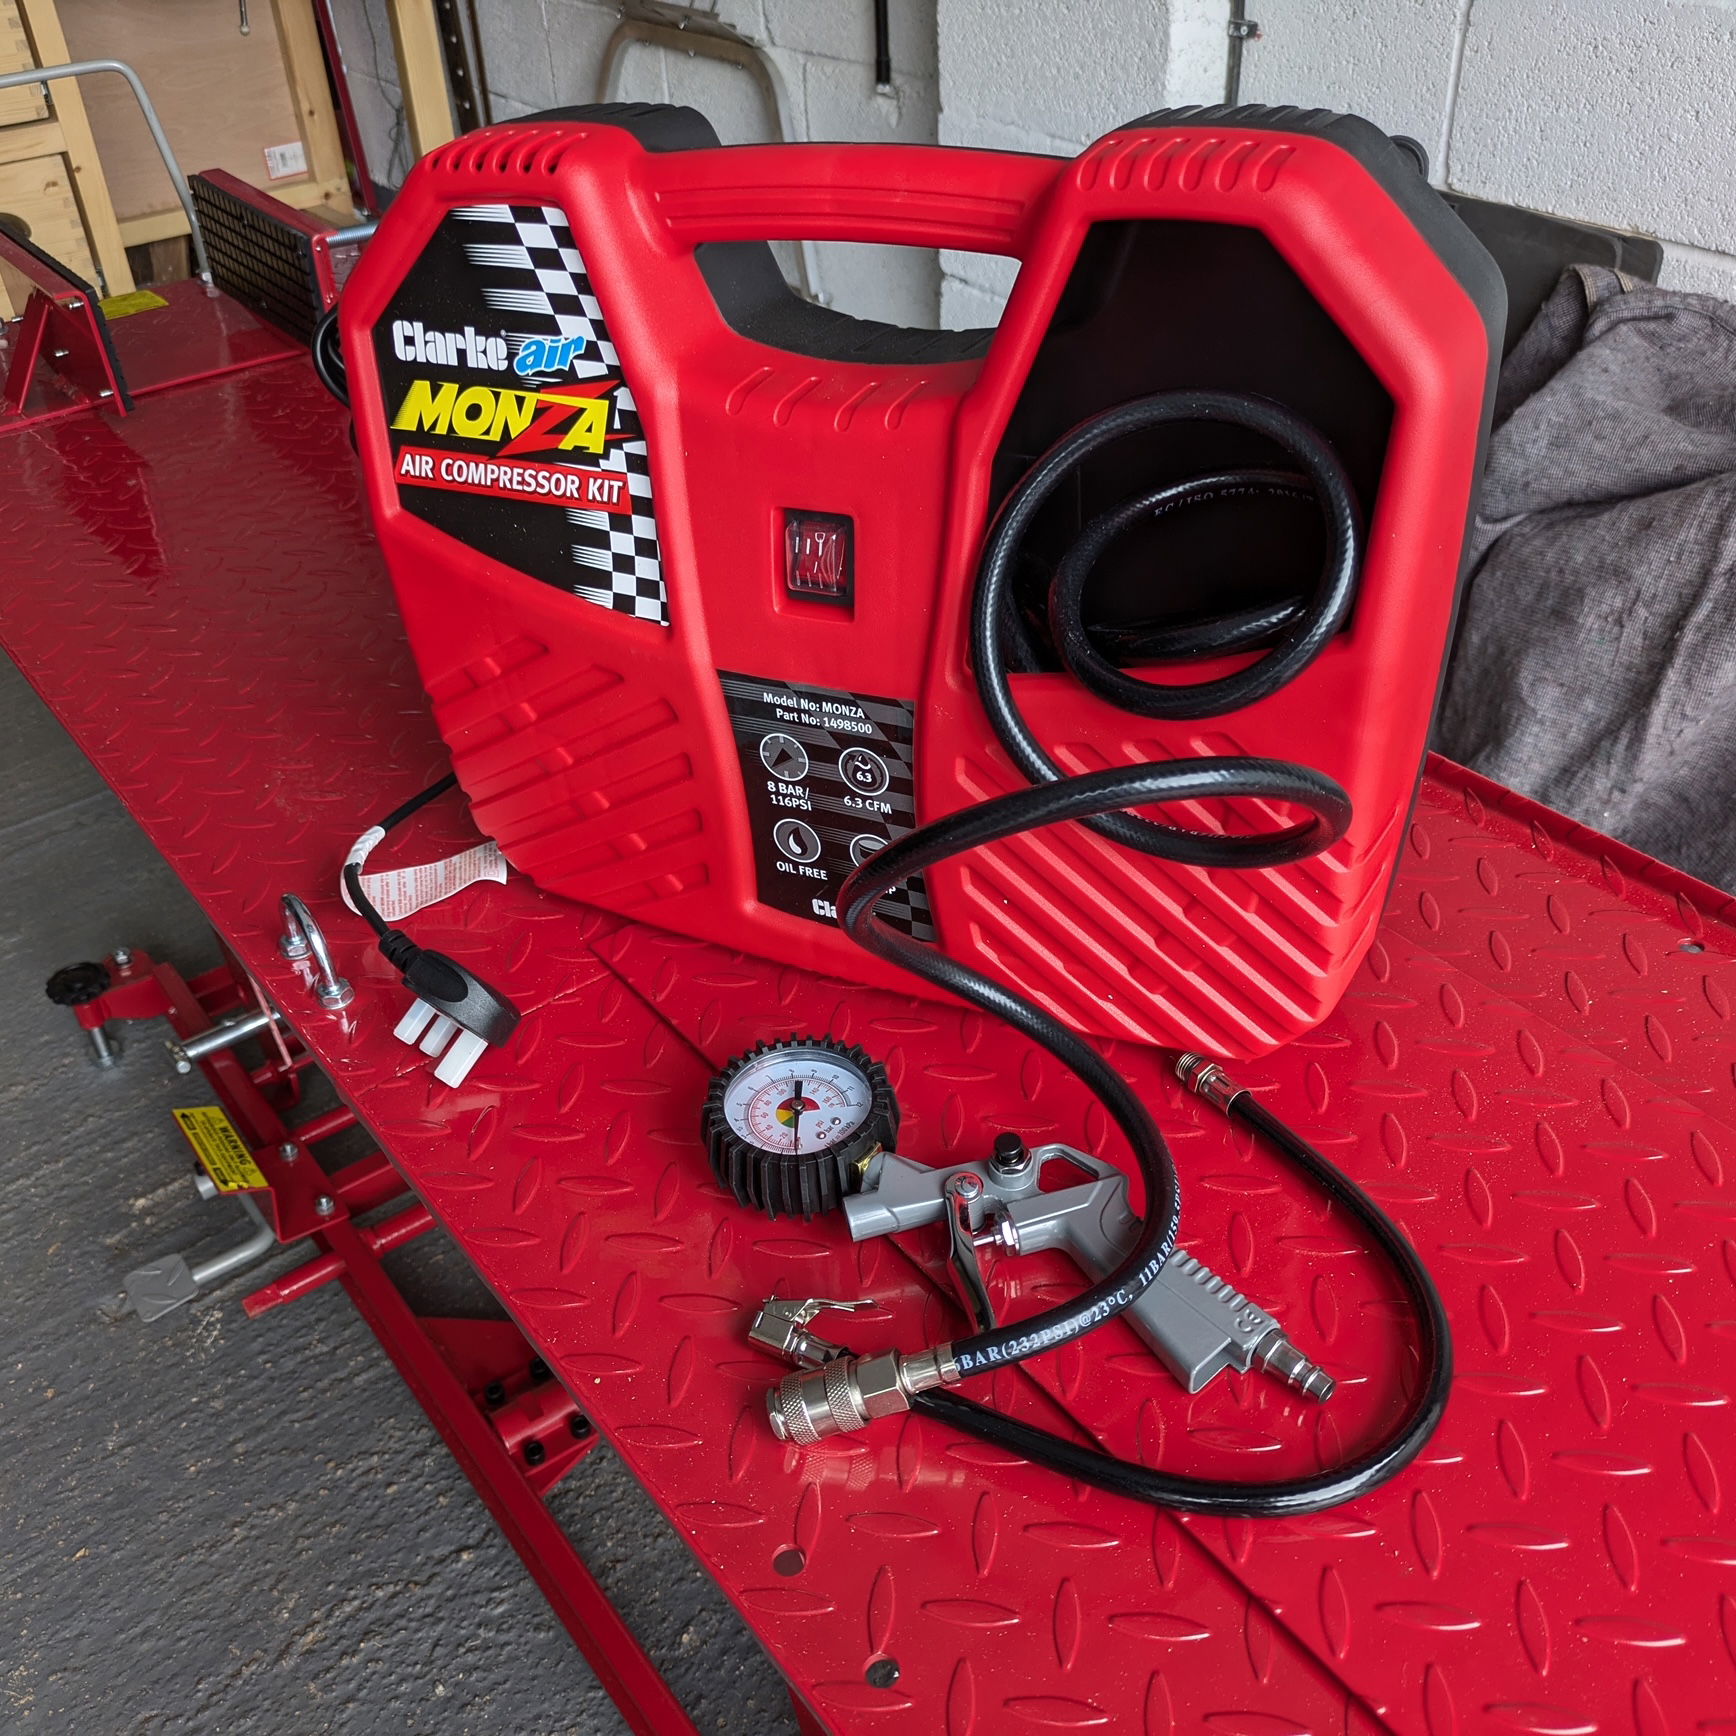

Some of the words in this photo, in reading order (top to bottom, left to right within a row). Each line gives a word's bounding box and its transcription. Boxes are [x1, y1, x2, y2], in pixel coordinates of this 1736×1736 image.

[392, 320, 508, 371] Clarke
[513, 335, 587, 376] air
[390, 379, 622, 458] MONZA
[400, 453, 433, 478] AIR
[440, 457, 580, 499] COMPRESSOR
[588, 477, 624, 504] KIT
[763, 692, 798, 708] Model
[800, 699, 820, 712] No:
[822, 702, 865, 719] MONZA
[776, 708, 800, 722] Part
[801, 713, 821, 727] No:
[823, 716, 872, 735] 1498500
[767, 781, 775, 792] 8
[856, 771, 872, 783] 6.3
[771, 794, 812, 811] 116PSI
[843, 795, 863, 809] 6.3
[865, 799, 892, 815] CFM
[776, 861, 797, 874] OIL
[799, 865, 828, 881] FREE
[811, 898, 838, 919] Cla
